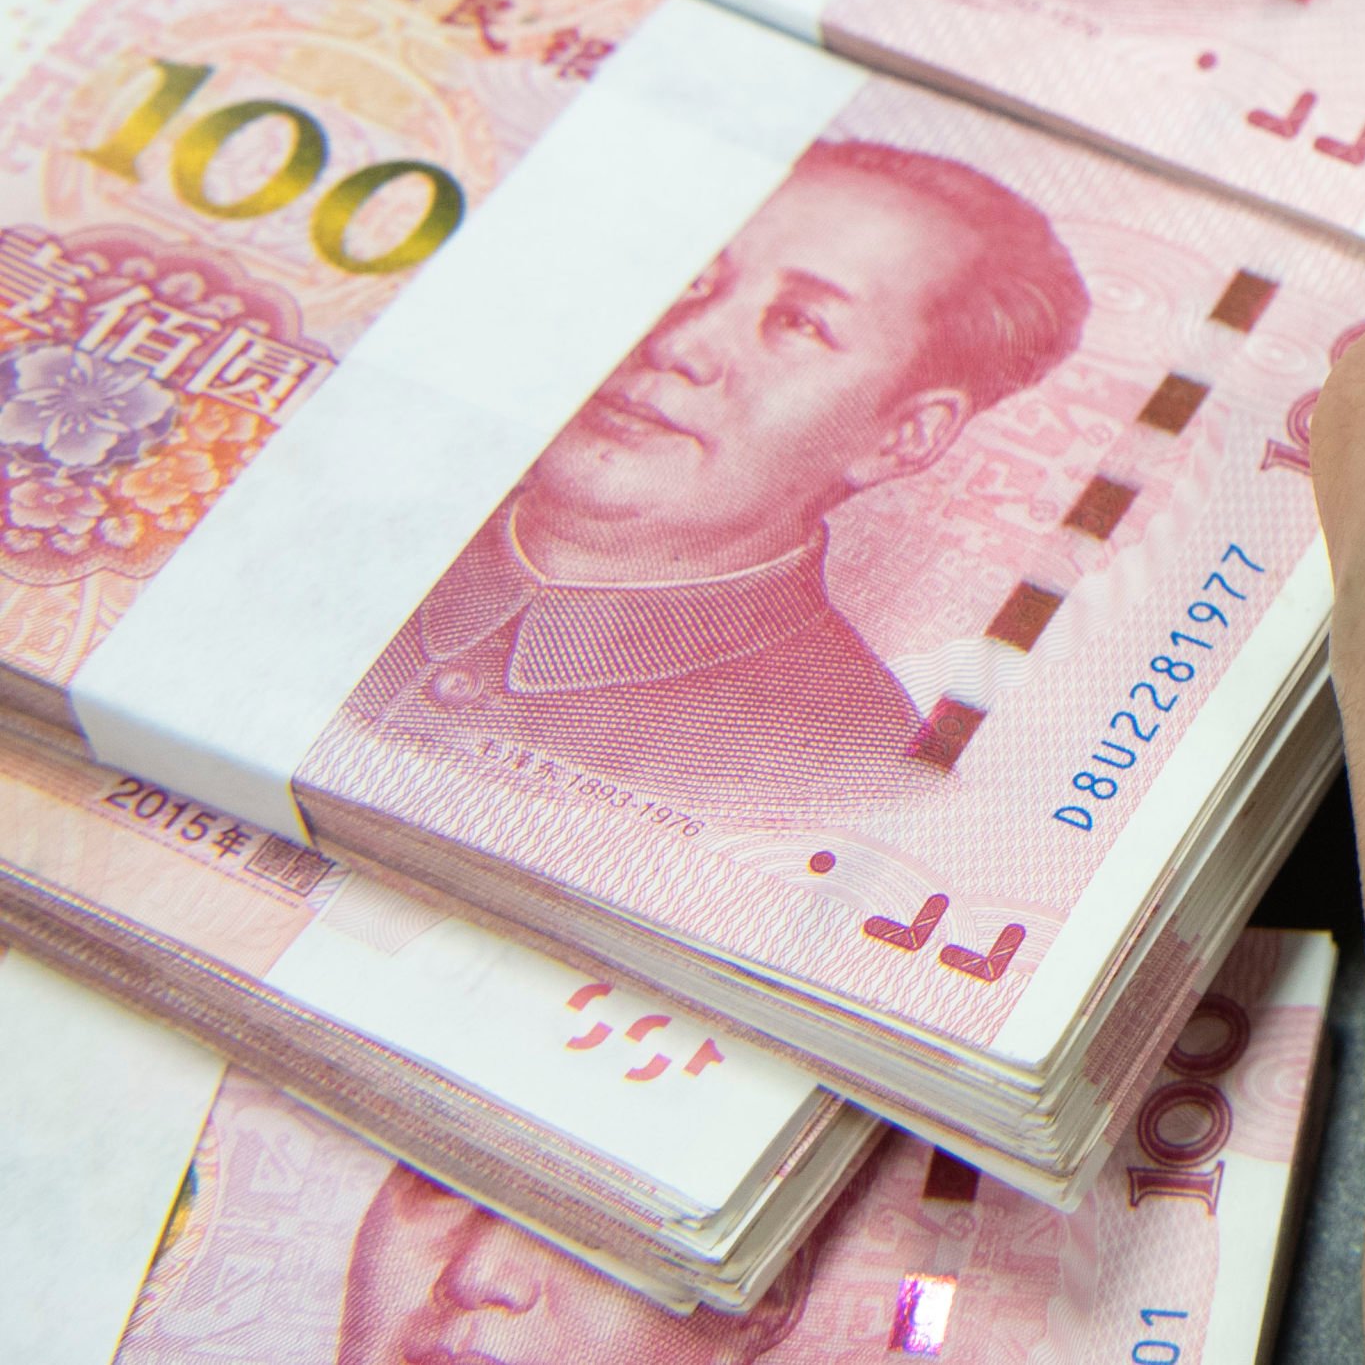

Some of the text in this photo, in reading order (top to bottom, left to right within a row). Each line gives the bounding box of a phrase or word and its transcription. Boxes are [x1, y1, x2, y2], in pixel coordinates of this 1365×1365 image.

[72, 56, 467, 275] 100
[1052, 543, 1266, 832] D8U2281977
[103, 775, 254, 859] 2015年
[567, 772, 706, 837] 1893-1976
[1127, 992, 1253, 1218] 100
